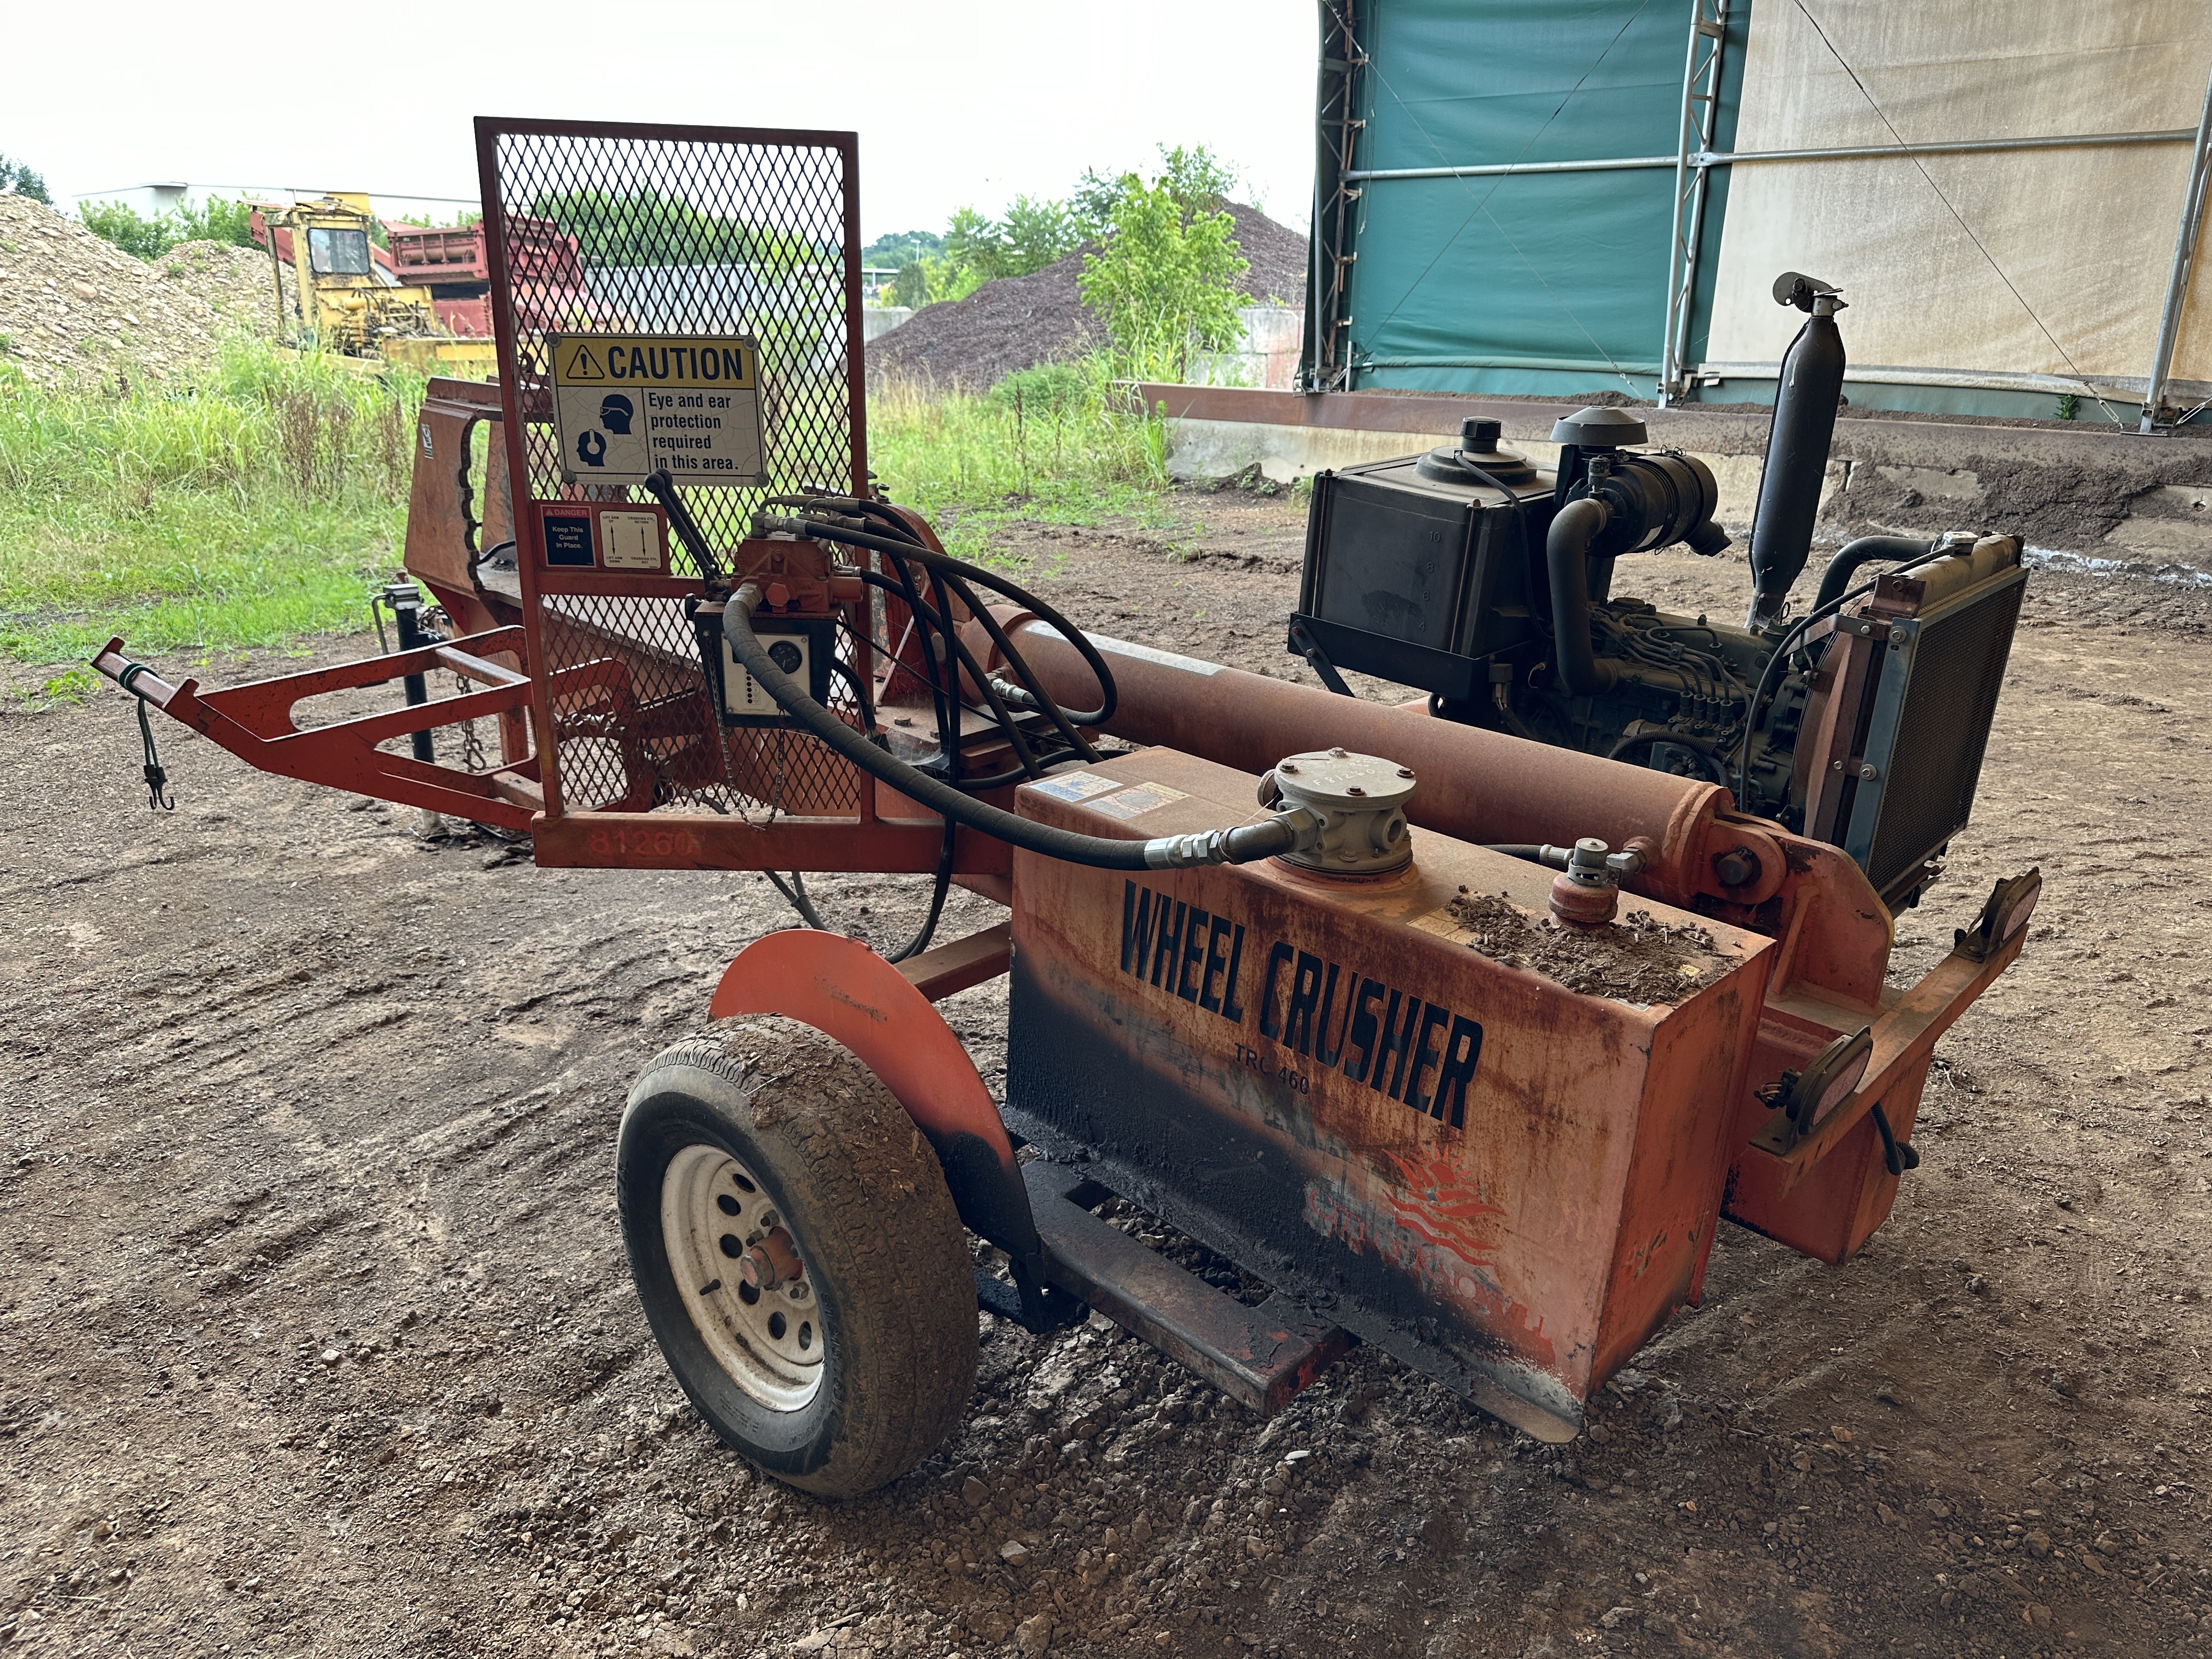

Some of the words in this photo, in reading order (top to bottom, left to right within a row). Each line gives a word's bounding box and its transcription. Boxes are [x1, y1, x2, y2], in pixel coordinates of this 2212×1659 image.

[608, 346, 743, 380] CAUTION
[648, 392, 673, 410] Eye
[678, 393, 704, 408] and
[708, 396, 731, 409] ear
[651, 414, 721, 430] protection
[653, 435, 712, 452] required
[654, 454, 668, 470] in
[672, 455, 697, 470] this
[702, 459, 738, 470] area.
[1429, 531, 1441, 543] 10
[1426, 561, 1435, 573] 8
[1422, 591, 1430, 601] 6
[1418, 622, 1426, 631] 4
[1120, 878, 1246, 1024] WHEEL
[1258, 940, 1484, 1131] CRUSHER
[1234, 1042, 1271, 1076] TRC
[1277, 1066, 1310, 1095] 460
